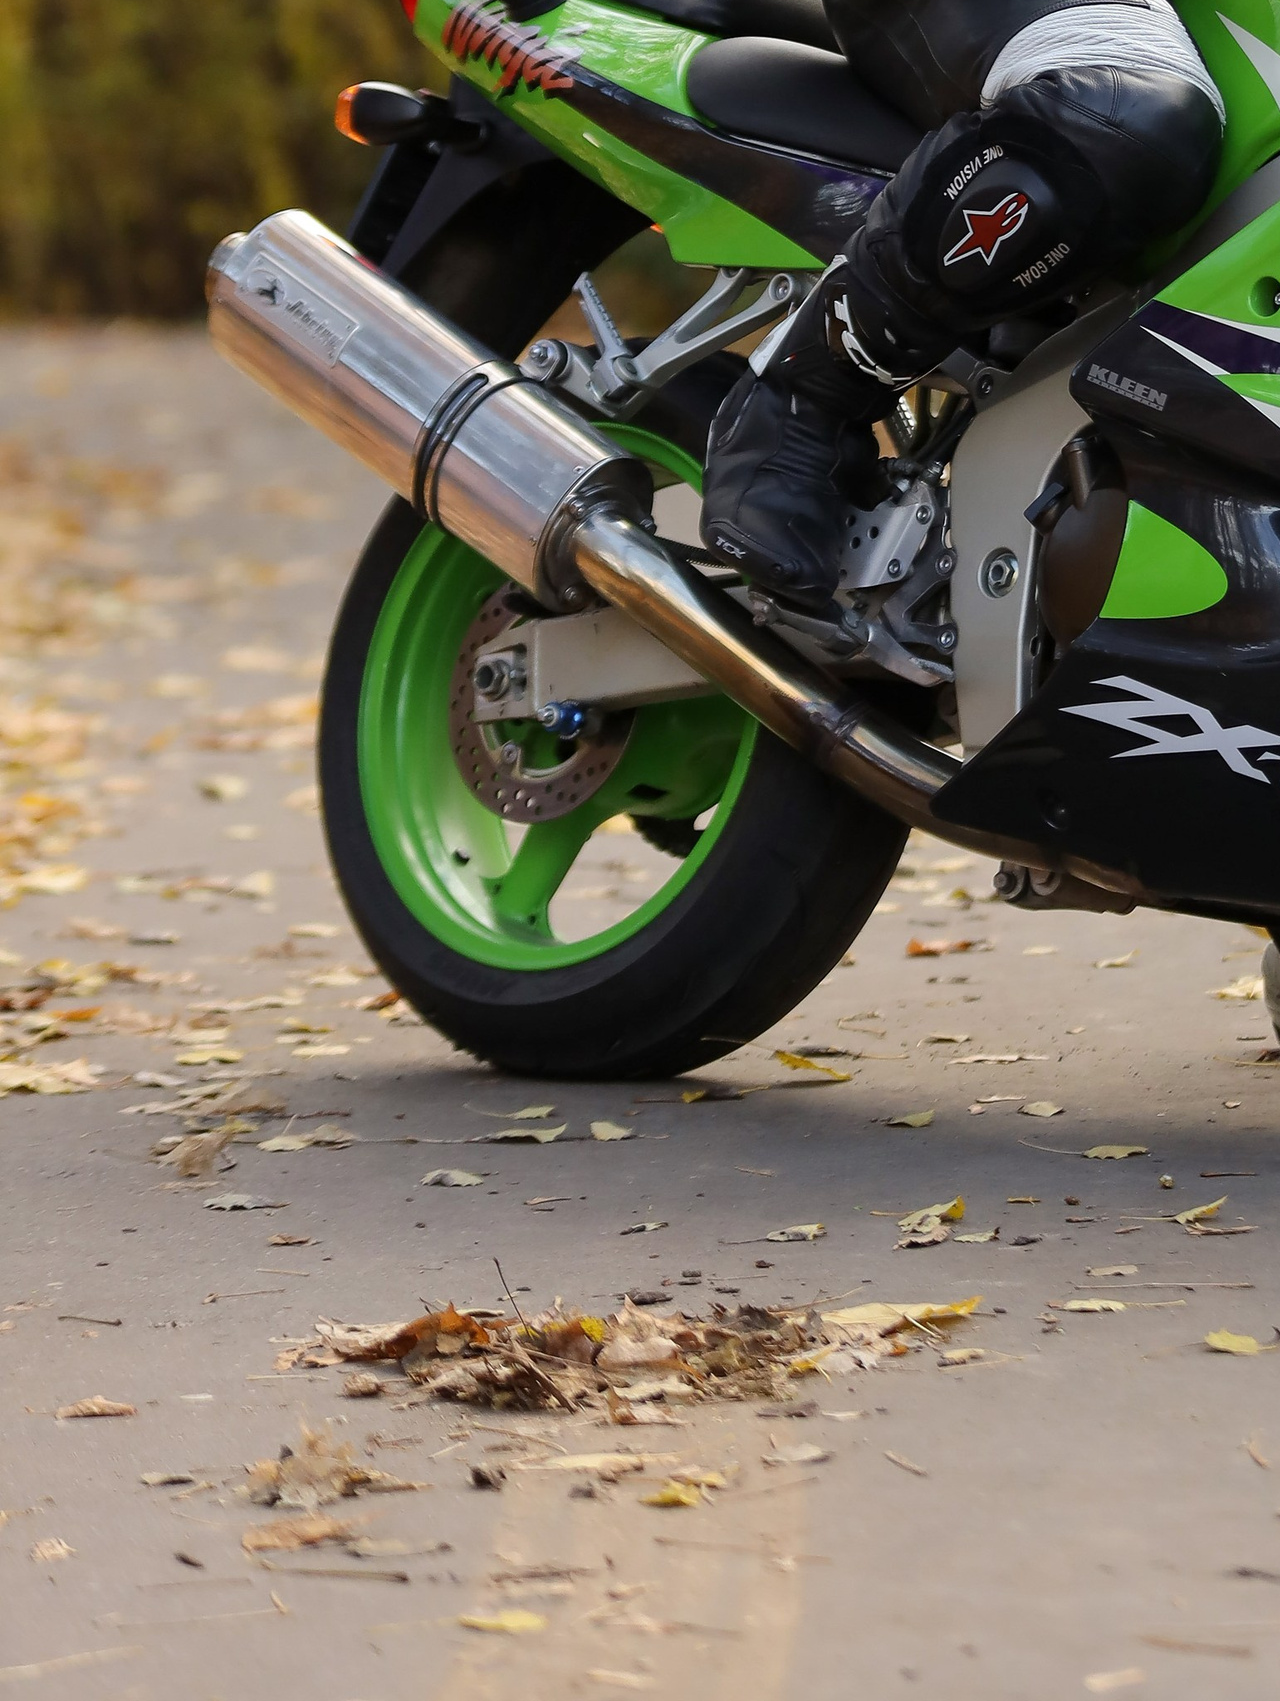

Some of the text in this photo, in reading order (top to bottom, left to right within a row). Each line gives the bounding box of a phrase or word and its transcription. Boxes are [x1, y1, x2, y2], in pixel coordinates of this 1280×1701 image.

[943, 144, 1004, 200] ONE VISION.
[1012, 242, 1071, 288] ONE GOAL.
[1088, 363, 1168, 407] KLEEN
[716, 536, 746, 559] TCX
